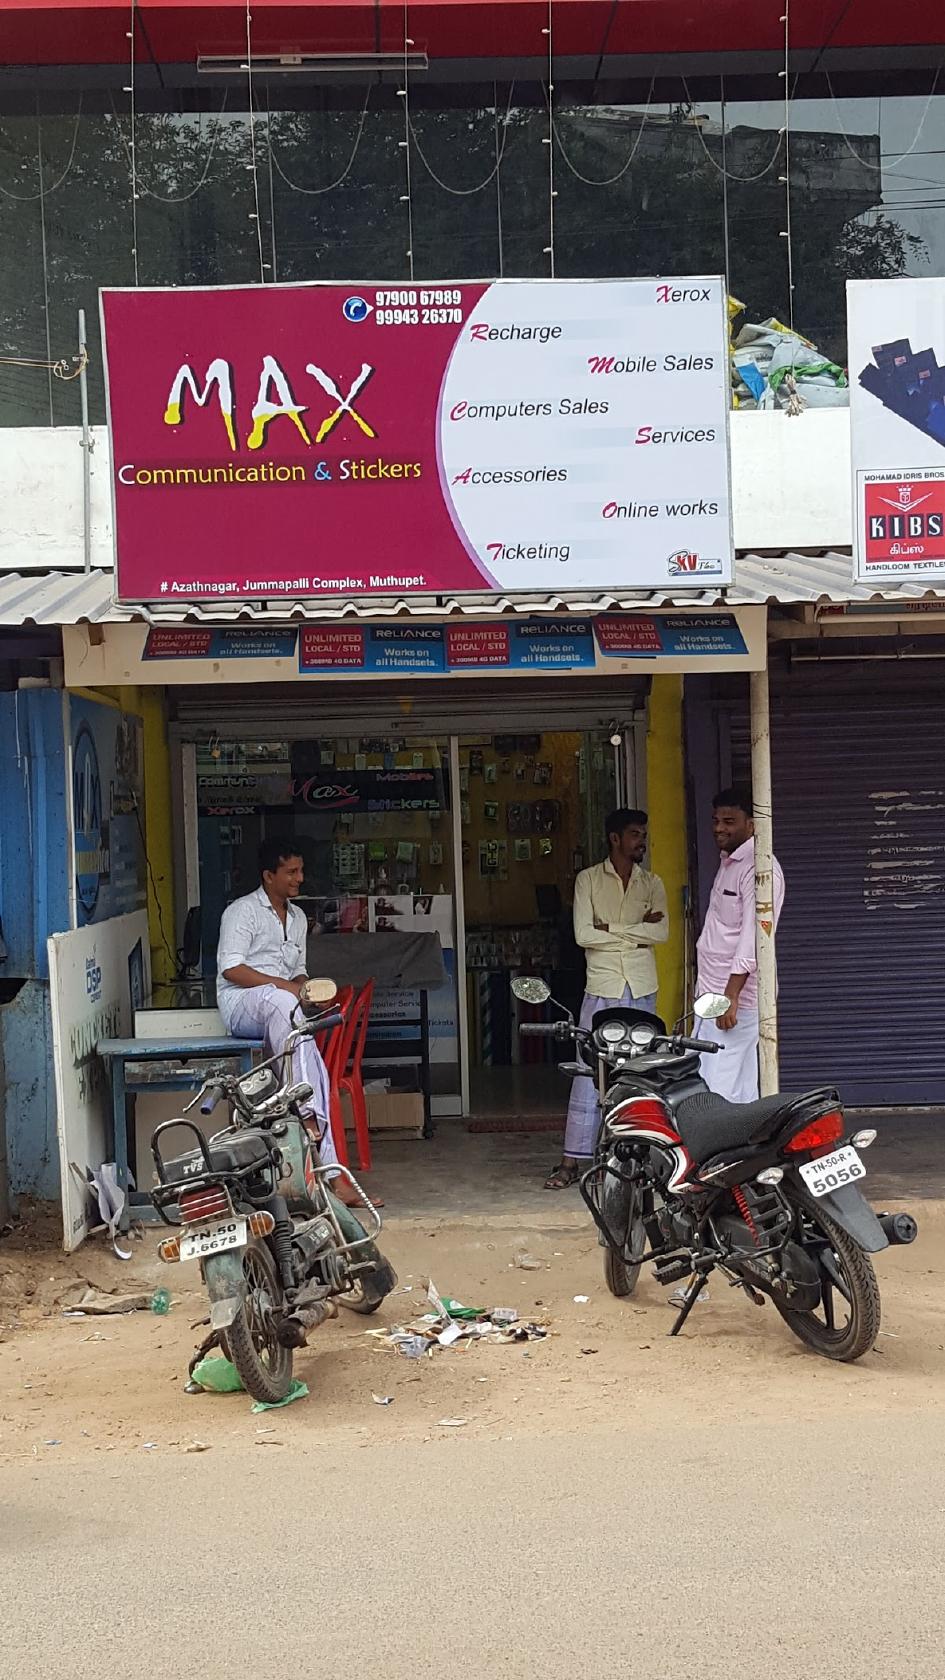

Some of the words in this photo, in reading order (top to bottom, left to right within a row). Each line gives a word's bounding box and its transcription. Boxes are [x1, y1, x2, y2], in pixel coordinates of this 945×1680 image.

[376, 291, 417, 305] 97900
[420, 290, 462, 304] 67989
[656, 285, 711, 303] Xerox
[376, 309, 418, 324] 99943
[422, 308, 462, 324] 26370
[470, 323, 562, 343] Recharge
[588, 356, 657, 374] Mobile
[663, 355, 713, 371] Sales
[164, 356, 377, 452] MAX
[450, 399, 552, 421] Computers
[559, 398, 609, 415] Sales
[635, 426, 715, 445] Services
[119, 462, 305, 485] Communication
[314, 461, 332, 481] &
[339, 459, 421, 480] Stickers
[452, 466, 567, 485] Accessories
[864, 473, 902, 481] MOHAMAD
[904, 472, 922, 480] IDRIS
[602, 501, 659, 519] Online
[666, 499, 718, 516] works
[871, 515, 941, 538] KIBS
[487, 543, 570, 561] Ticketing
[865, 563, 910, 571] HANDLOOM
[160, 582, 168, 592] #
[171, 580, 240, 593] Azathnagar,
[243, 577, 309, 591] Jummapalli
[313, 576, 366, 590] Complex,
[369, 575, 426, 588] Muthupet.
[598, 623, 655, 632] UNLIMITED
[304, 633, 362, 643] UNLIMITED
[449, 630, 507, 641] UNLIMITED
[638, 632, 656, 640] STD
[680, 635, 709, 643] Works
[711, 635, 724, 643] on
[305, 645, 334, 653] LOCAL
[342, 644, 360, 653] STD
[384, 648, 412, 658] Works
[414, 648, 429, 657] on
[450, 643, 481, 652] LOCAL
[487, 642, 506, 651] STD
[529, 644, 560, 653] Works
[562, 644, 574, 653] on
[673, 643, 686, 651] all
[375, 657, 388, 667] all
[520, 654, 533, 664] all
[183, 1162, 203, 1174] TVS
[810, 1153, 847, 1173] TN-50-R
[813, 1164, 862, 1193] 5056
[187, 1223, 237, 1242] TN.50
